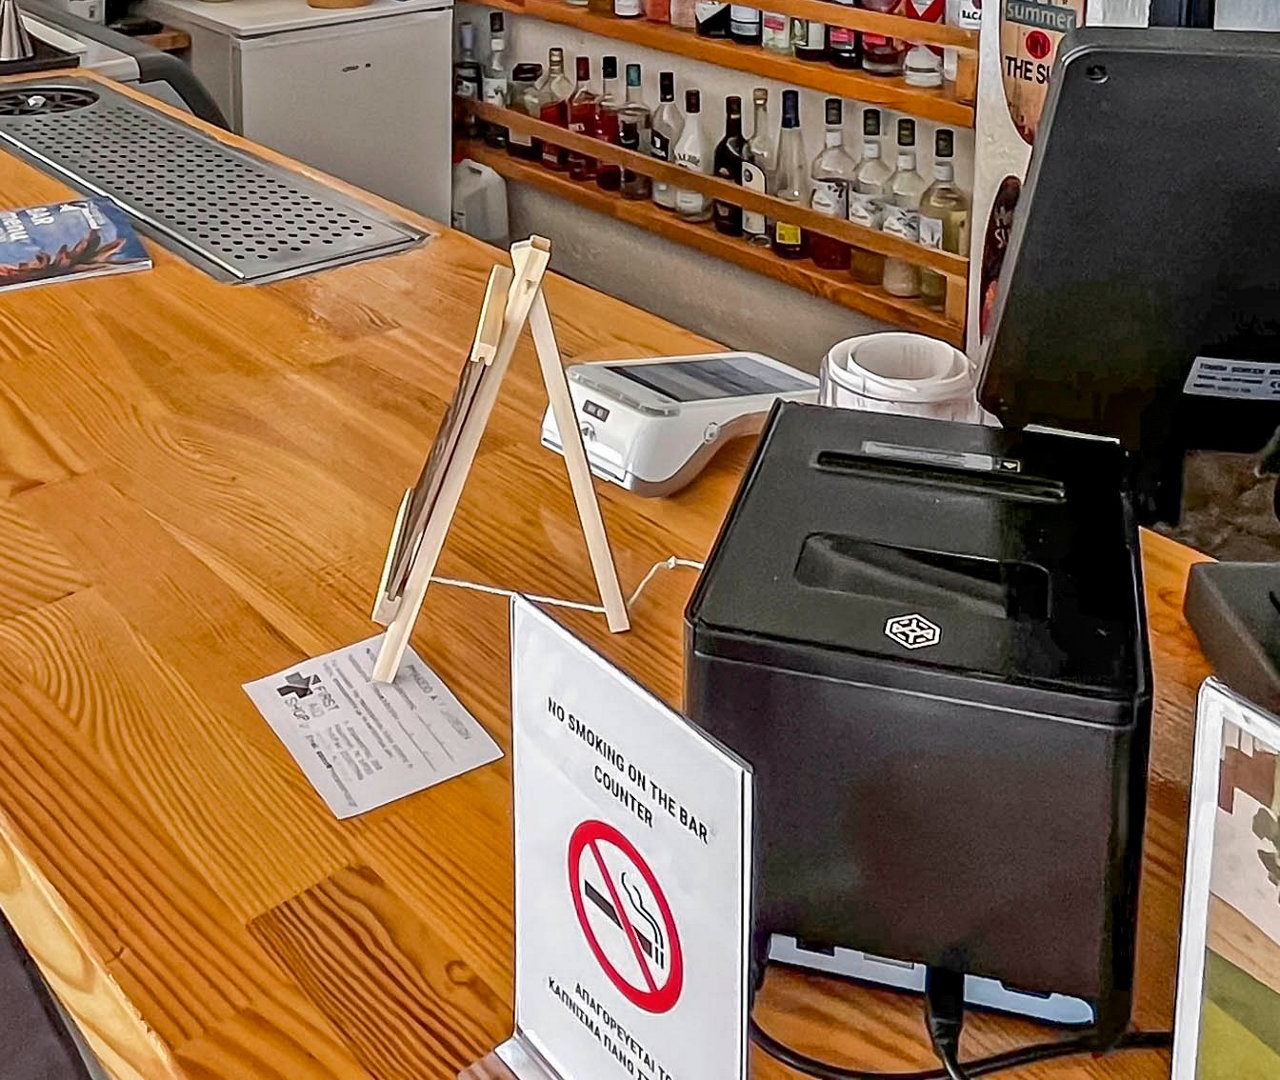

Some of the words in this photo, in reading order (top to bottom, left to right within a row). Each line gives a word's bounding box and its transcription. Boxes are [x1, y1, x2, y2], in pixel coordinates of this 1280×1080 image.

[1007, 2, 1074, 29] summer
[1005, 56, 1033, 81] THE
[548, 697, 564, 722] NO
[568, 714, 625, 772] SMOKING
[628, 764, 646, 791] ON
[650, 780, 676, 818] THE
[679, 806, 708, 845] BAR
[594, 765, 653, 829] COUNTER
[548, 977, 601, 1041] ΚΑΠΝΙΣΜΑ
[604, 1034, 634, 1076] ΠΑΝΩ
[575, 982, 655, 1073] ΑΠΑΓΟΡΕΥΕΤΑΙ
